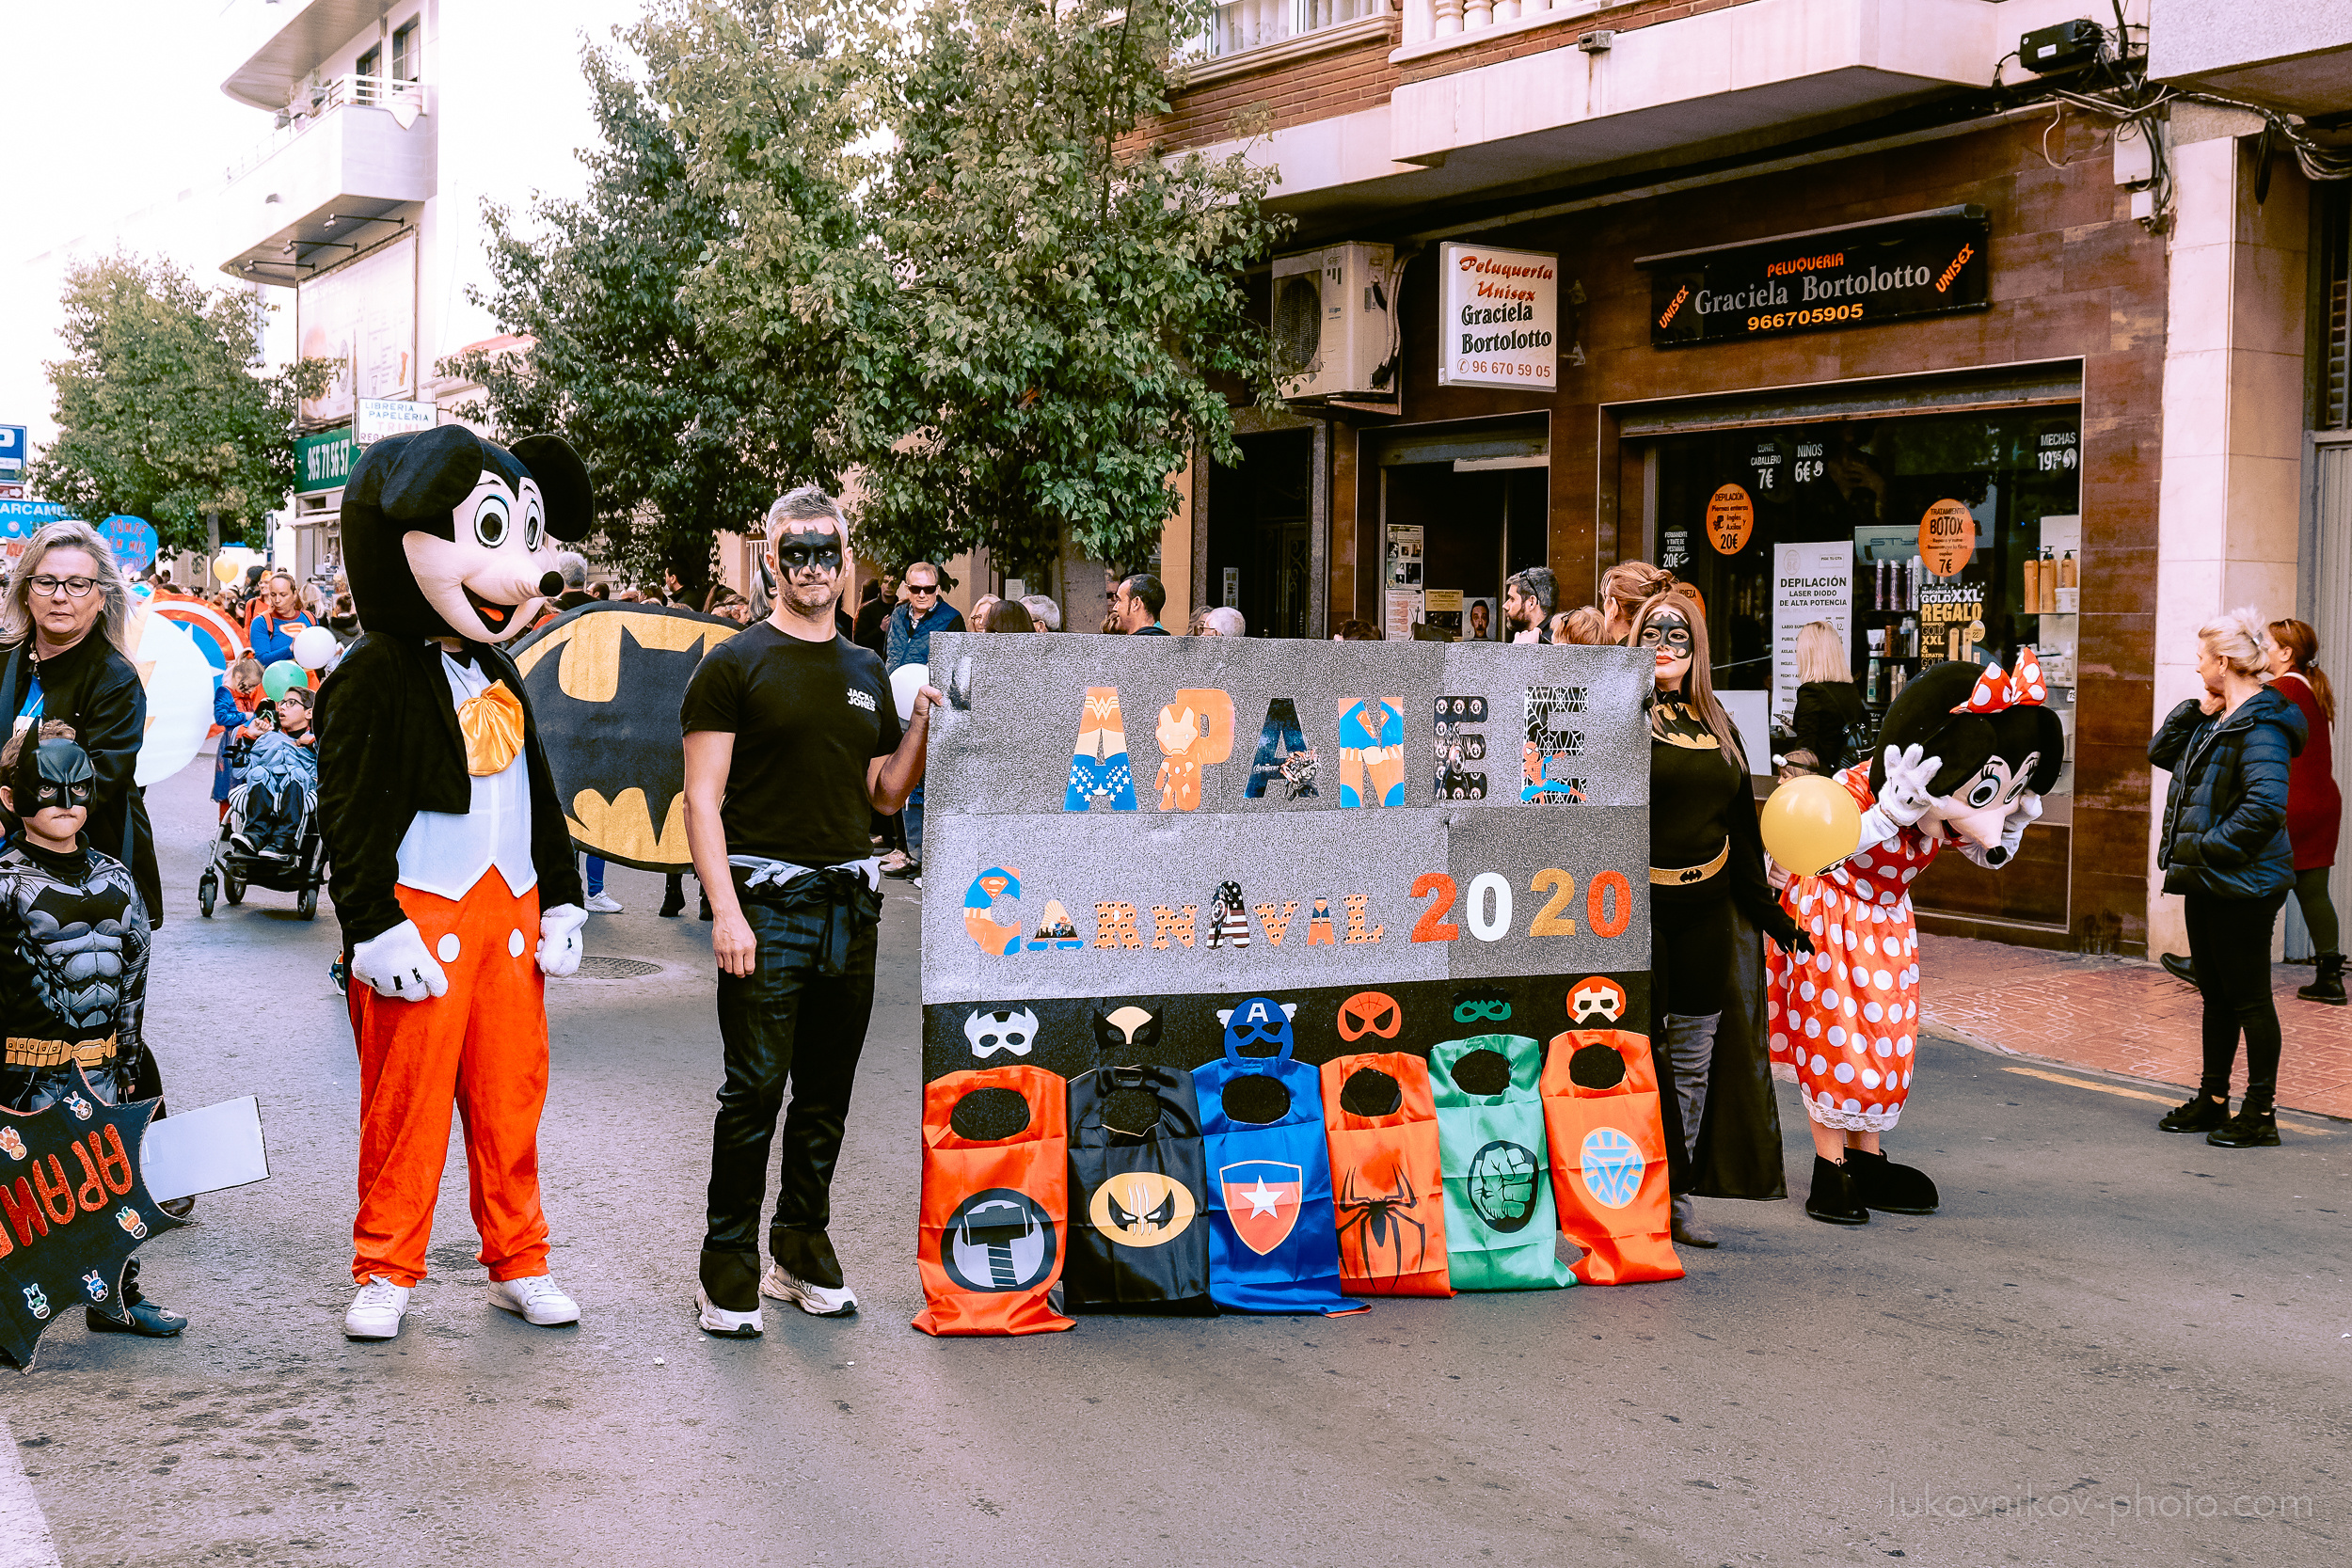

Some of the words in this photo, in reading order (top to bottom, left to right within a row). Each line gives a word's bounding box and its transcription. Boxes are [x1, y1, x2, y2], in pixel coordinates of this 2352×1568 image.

[1767, 252, 1844, 277] PELUQUERIA
[1935, 243, 1975, 293] UNISEX
[1477, 281, 1536, 301] Unisex
[1694, 280, 1788, 315] Graciela
[1802, 265, 1931, 302] Bortolotto
[1461, 301, 1534, 325] Graciela
[1659, 285, 1690, 328] UNISEX
[1747, 303, 1864, 331] 966705905
[1461, 329, 1552, 354] Bortolotto
[1472, 360, 1487, 373] 96
[1491, 361, 1514, 375] 670
[1518, 363, 1533, 376] 59
[1535, 364, 1551, 377] 05
[365, 402, 414, 412] LIBRERIA
[369, 411, 429, 421] PAPELERIA
[2041, 432, 2076, 446] MECHAS
[1757, 443, 1774, 453] CORTE
[1797, 441, 1823, 457] NIÑOS
[308, 446, 320, 482] 965
[322, 443, 329, 479] 71
[331, 441, 340, 477] 56
[341, 438, 350, 475] 57
[1751, 455, 1781, 467] CABALLERO
[1758, 468, 1773, 489] 7€
[1795, 461, 1811, 483] 6€
[1715, 492, 1744, 502] DEPILACIÓN
[1930, 516, 1963, 536] BOTOX
[1720, 533, 1739, 549] 20€
[1663, 553, 1678, 568] 20€
[1939, 559, 1952, 574] 7€
[1780, 575, 1847, 588] DEPILACIÓN
[1810, 598, 1847, 607] POTENCIA
[1921, 594, 1951, 603] GOLD
[1951, 588, 1982, 603] XXL
[1921, 602, 1982, 622] REGALO
[1921, 626, 1945, 636] GOLD
[1921, 635, 1946, 645] XXL
[1921, 645, 1929, 654] &
[848, 697, 876, 712] JONES
[1063, 686, 1589, 813] APANEE
[1409, 867, 1632, 944] 2020
[1246, 1003, 1269, 1023] A
